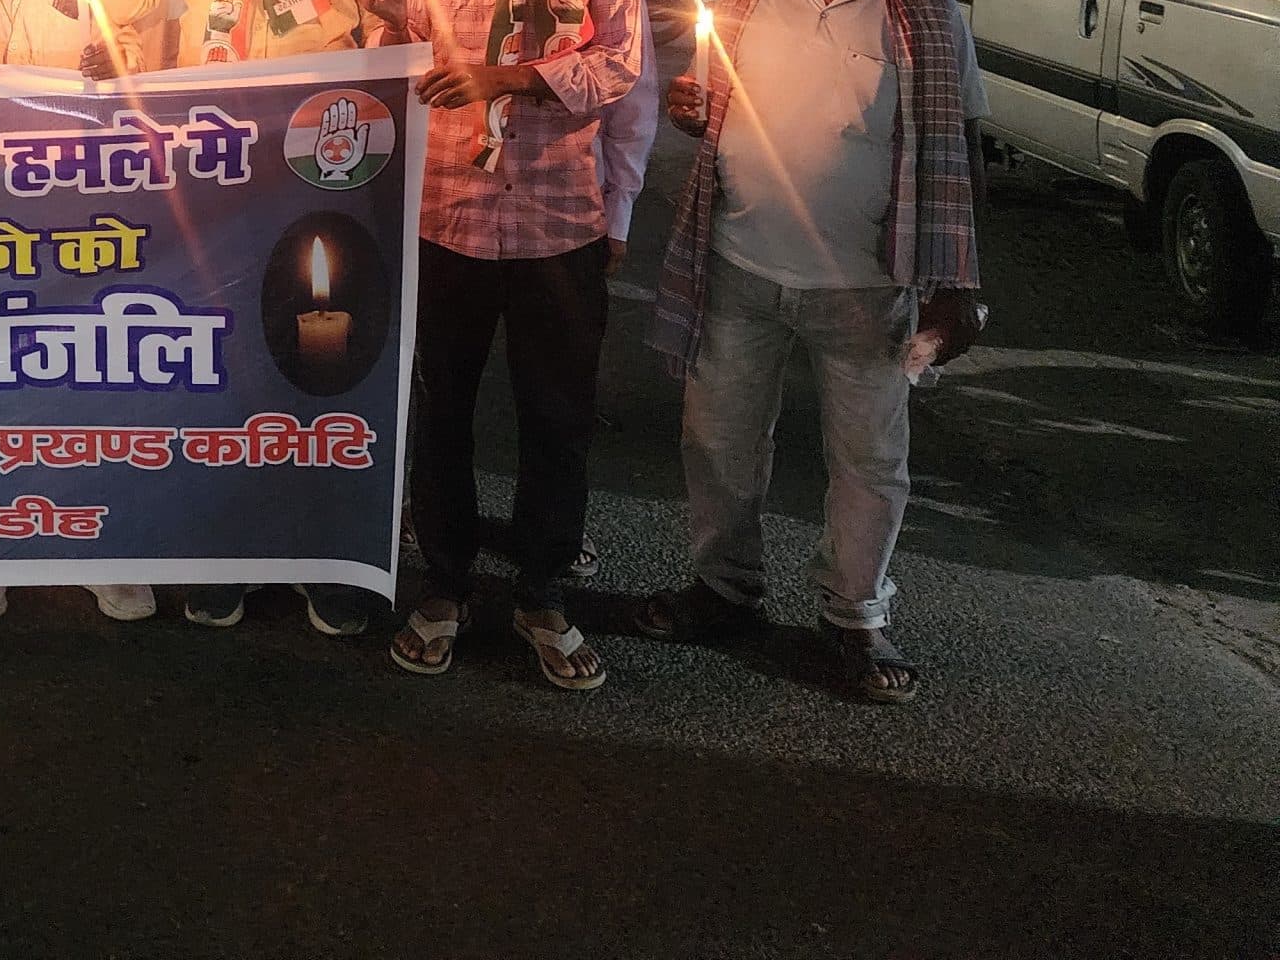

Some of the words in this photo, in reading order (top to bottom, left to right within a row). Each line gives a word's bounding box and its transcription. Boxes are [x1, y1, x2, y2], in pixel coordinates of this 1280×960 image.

[181, 105, 258, 186] मे
[51, 217, 146, 275] को
[181, 413, 377, 470] कमिटि
